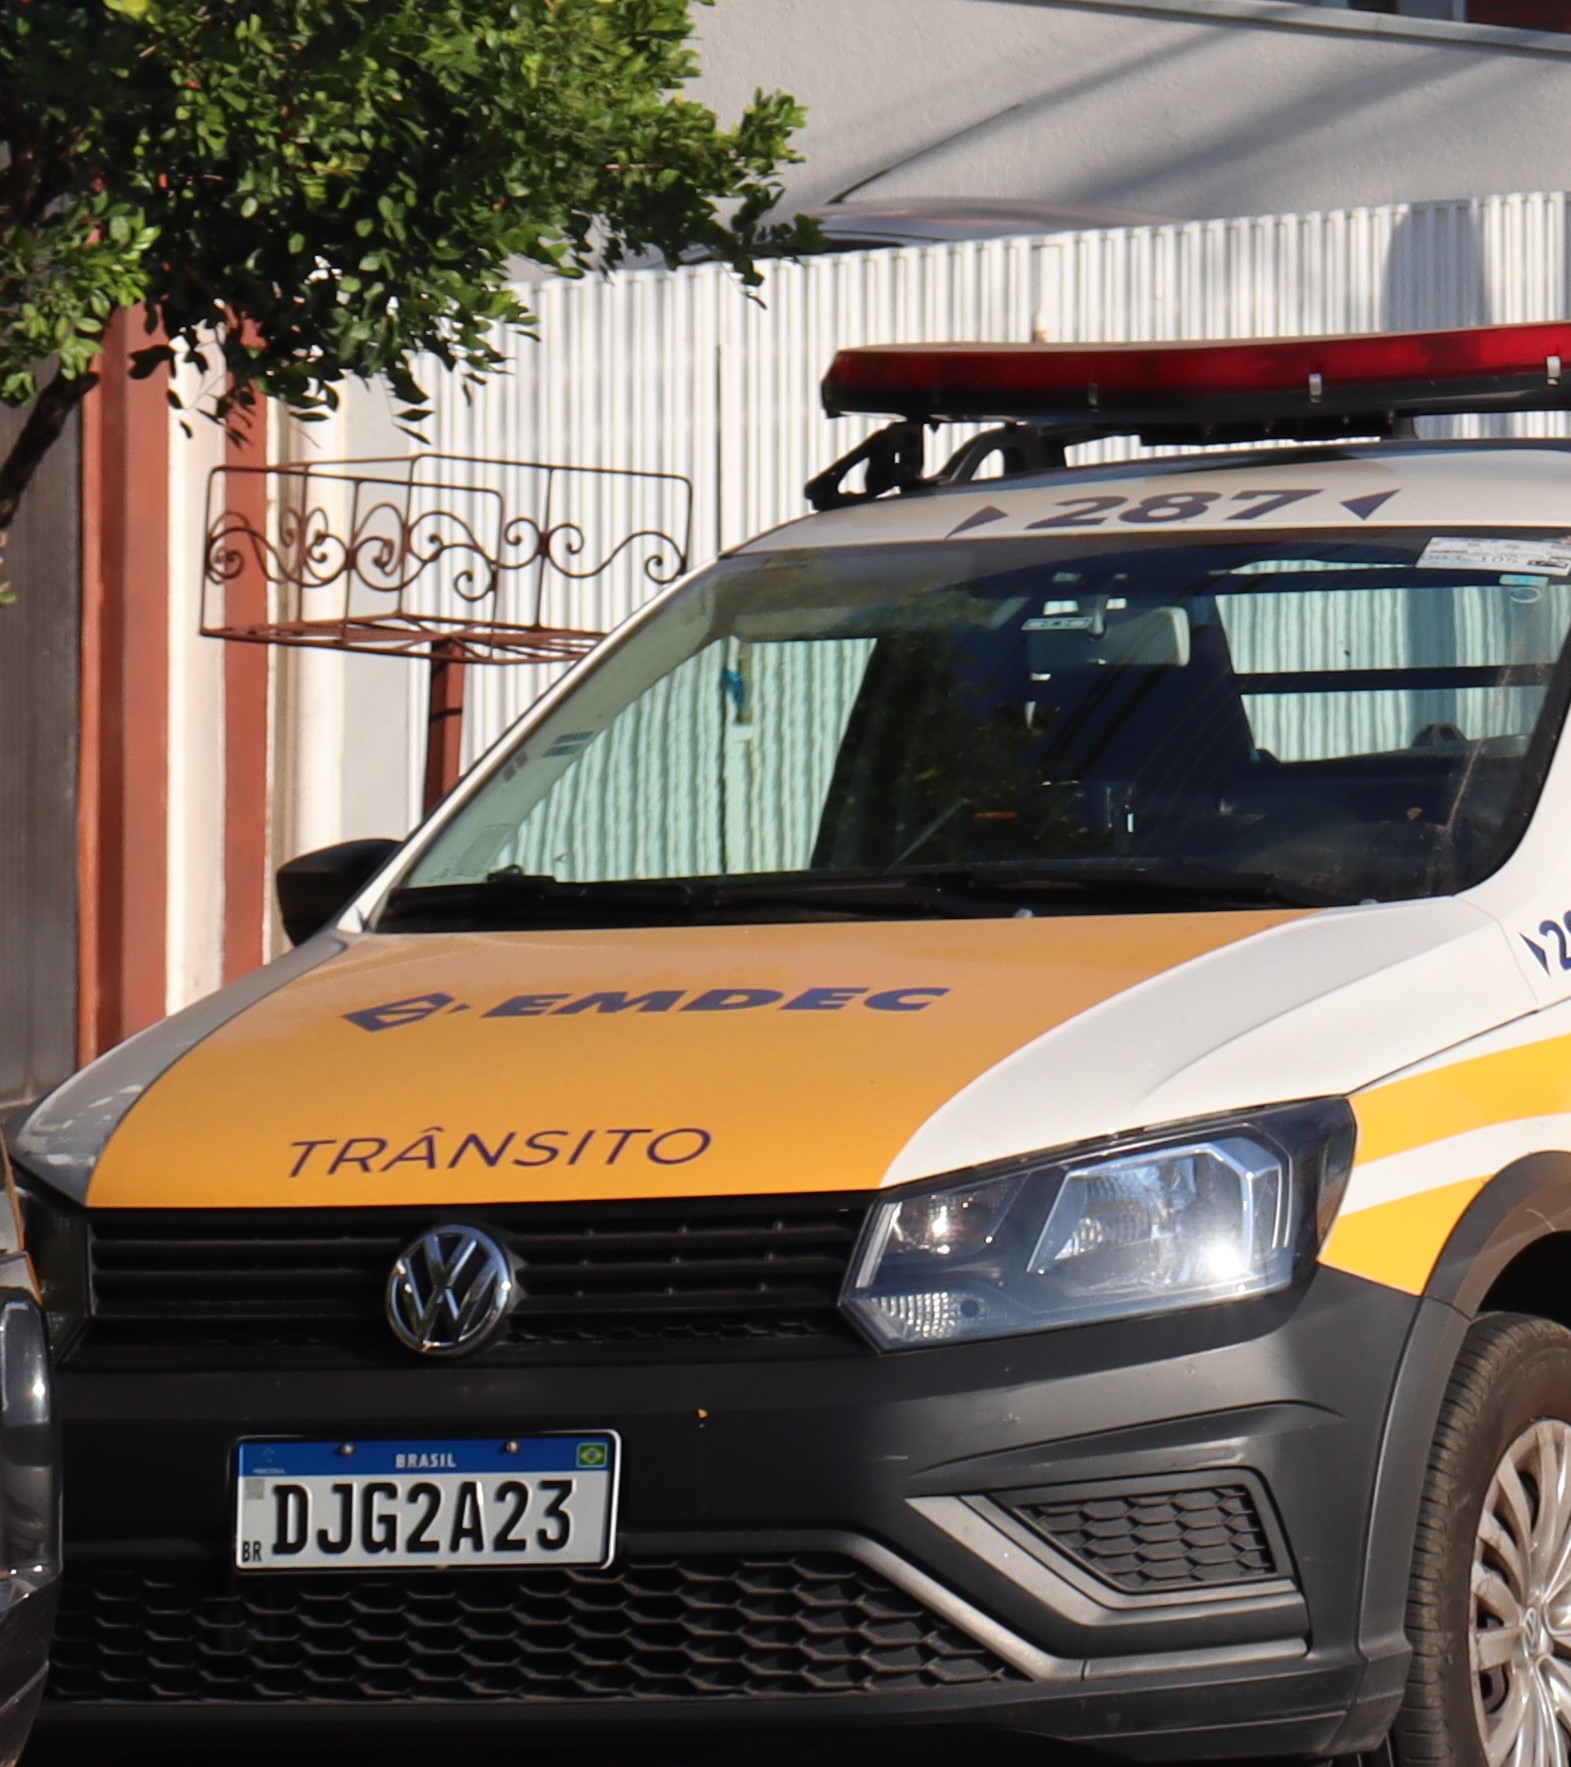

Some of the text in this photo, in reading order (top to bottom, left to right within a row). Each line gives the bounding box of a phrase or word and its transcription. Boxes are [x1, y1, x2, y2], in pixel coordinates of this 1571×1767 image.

[1024, 488, 1325, 530] 287
[479, 987, 952, 1019] EMDEC
[287, 1126, 712, 1178] TRÂNSITO
[395, 1453, 457, 1470] BRASIL
[271, 1478, 576, 1555] DJG2A23
[241, 1540, 263, 1563] BR
